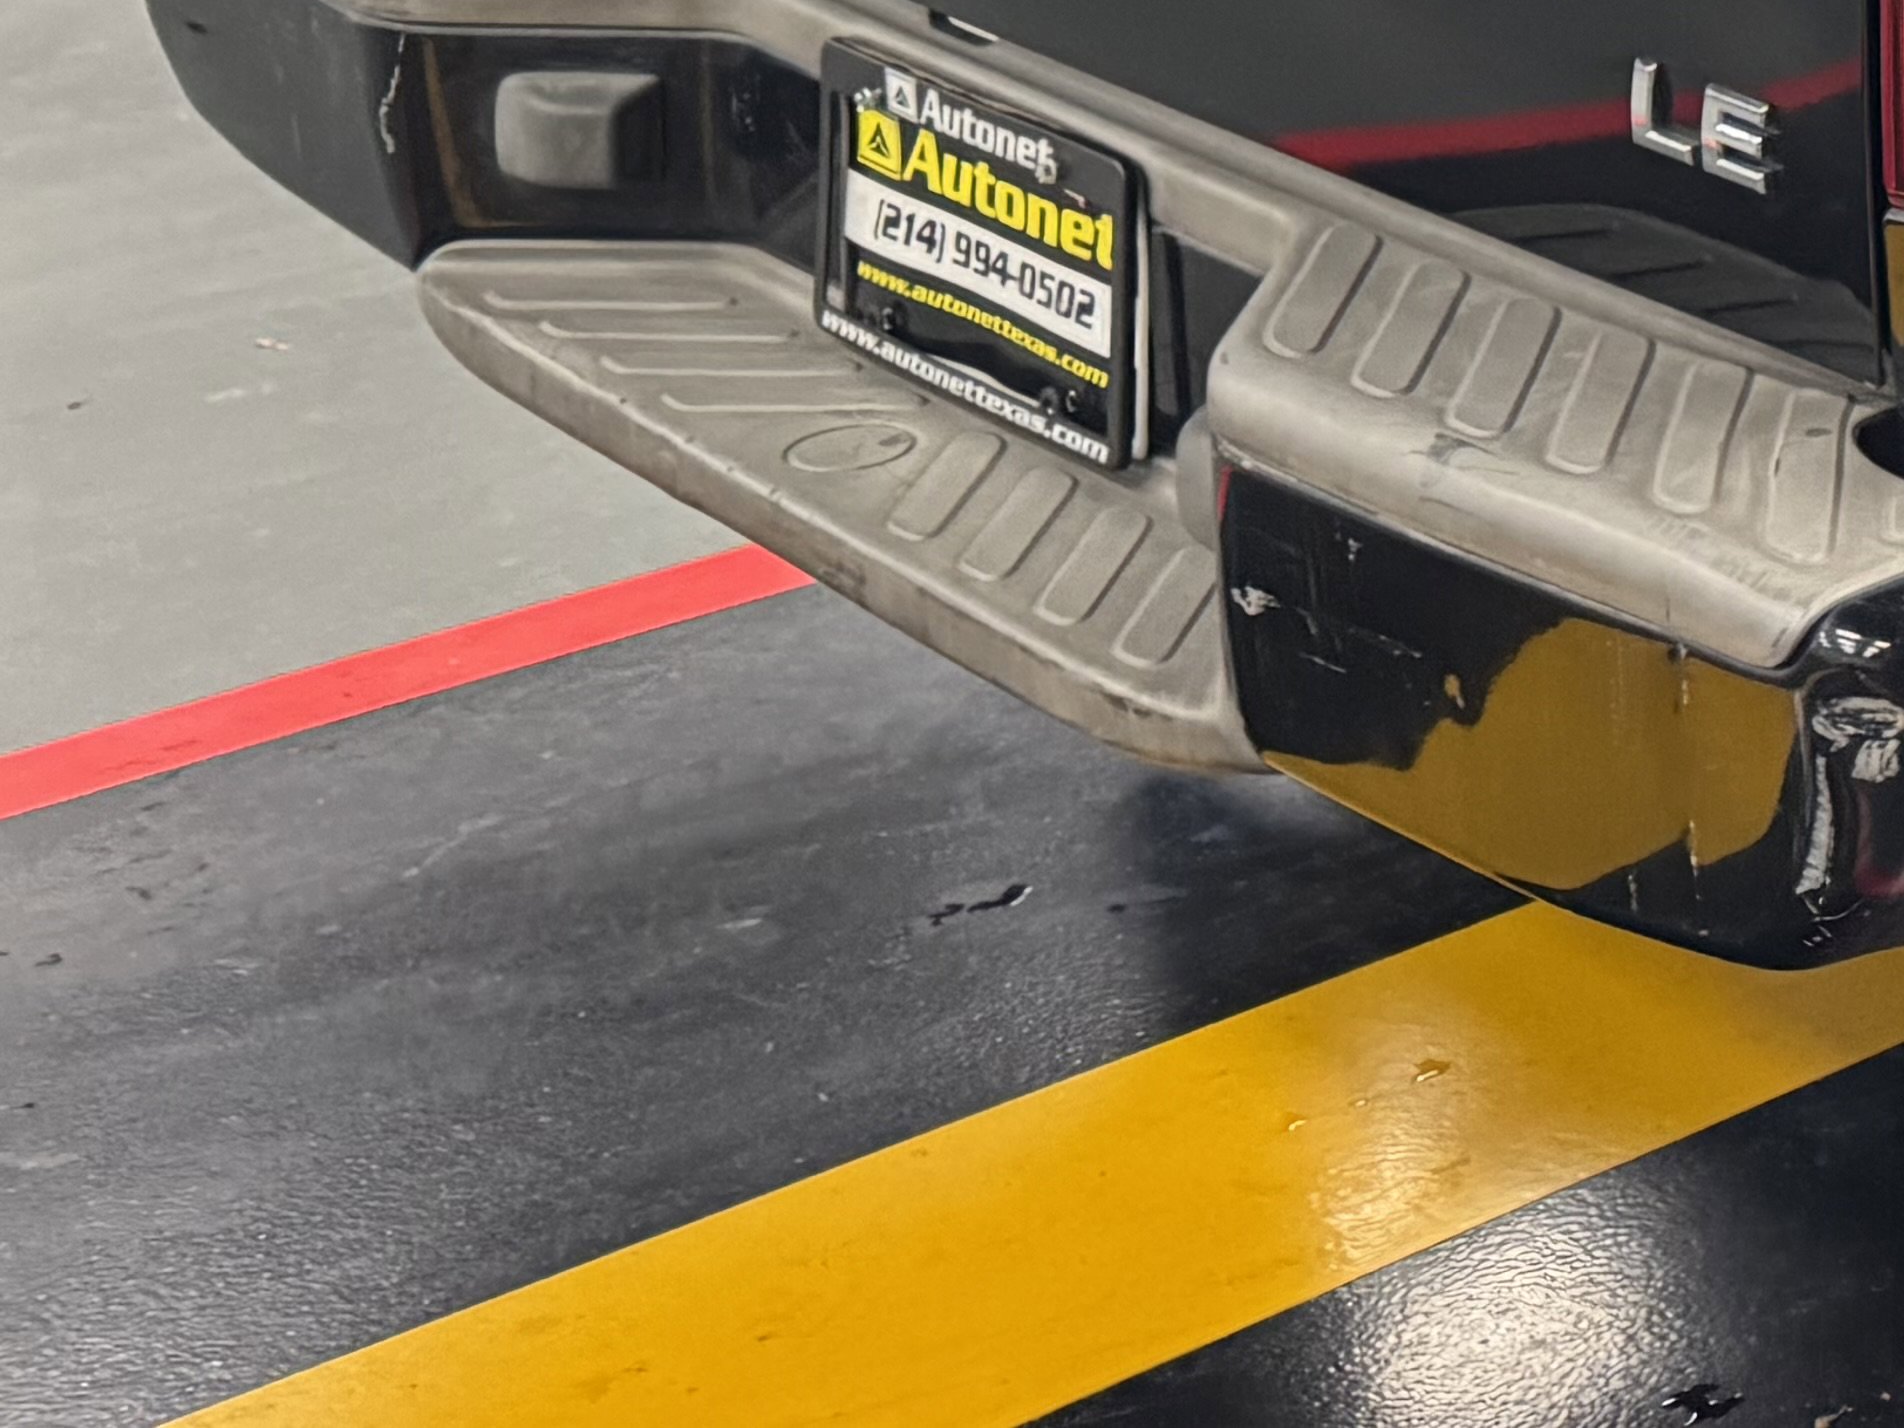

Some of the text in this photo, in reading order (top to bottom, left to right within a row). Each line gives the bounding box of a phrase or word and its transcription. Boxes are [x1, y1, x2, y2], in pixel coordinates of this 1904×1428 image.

[1631, 57, 1769, 194] LE
[874, 199, 1096, 330] (214) 994-0502
[903, 128, 1113, 271] Autonet
[822, 309, 1110, 464] www.autonettexas.com
[857, 260, 1110, 388] www.autonettexas.com
